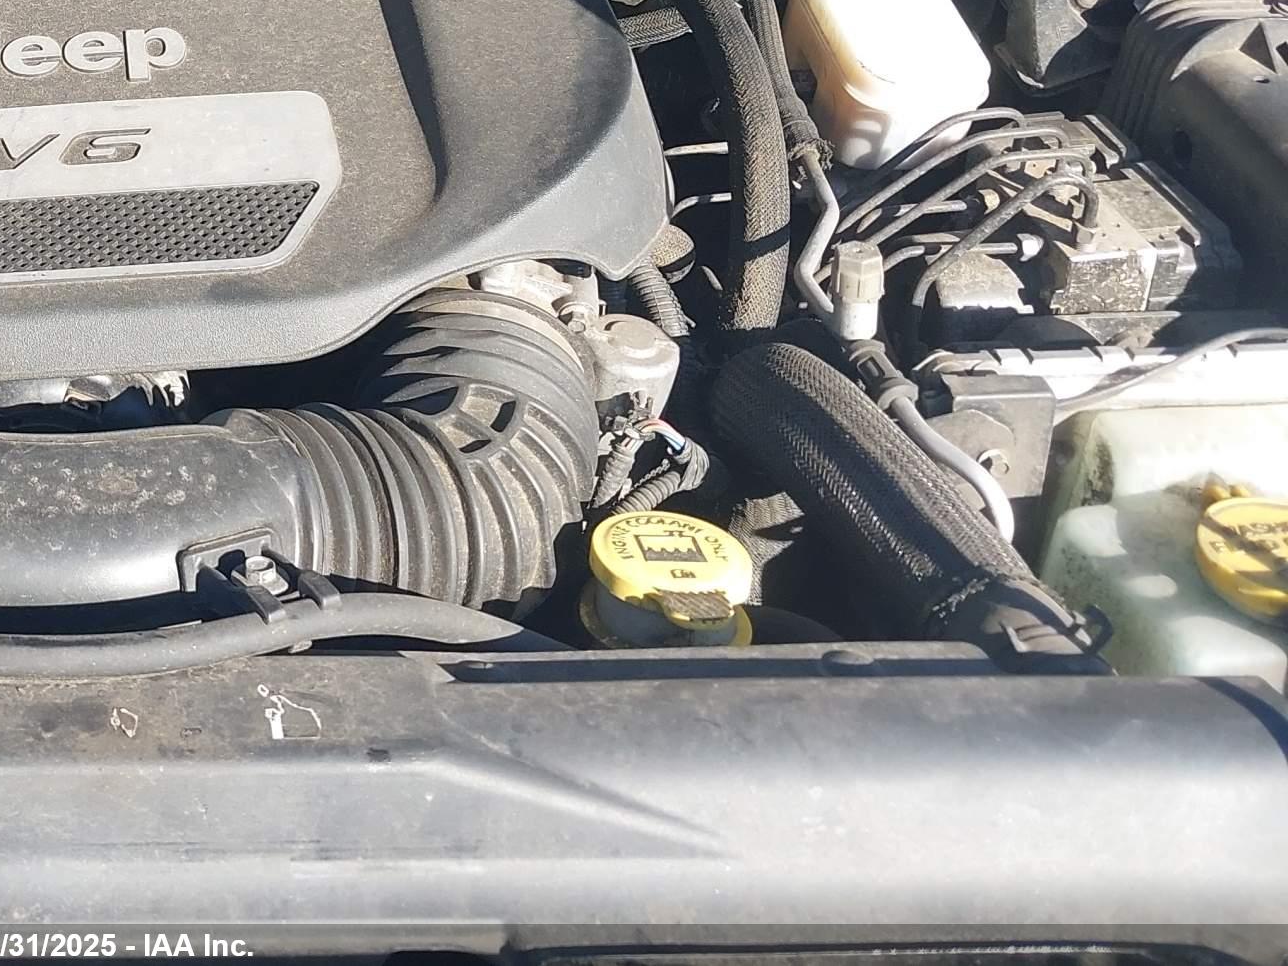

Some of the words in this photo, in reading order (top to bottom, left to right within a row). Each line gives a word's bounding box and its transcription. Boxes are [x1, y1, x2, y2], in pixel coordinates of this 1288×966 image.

[610, 526, 635, 561] ENGINE
[626, 516, 704, 534] COOLANT
[704, 536, 730, 563] ONLY
